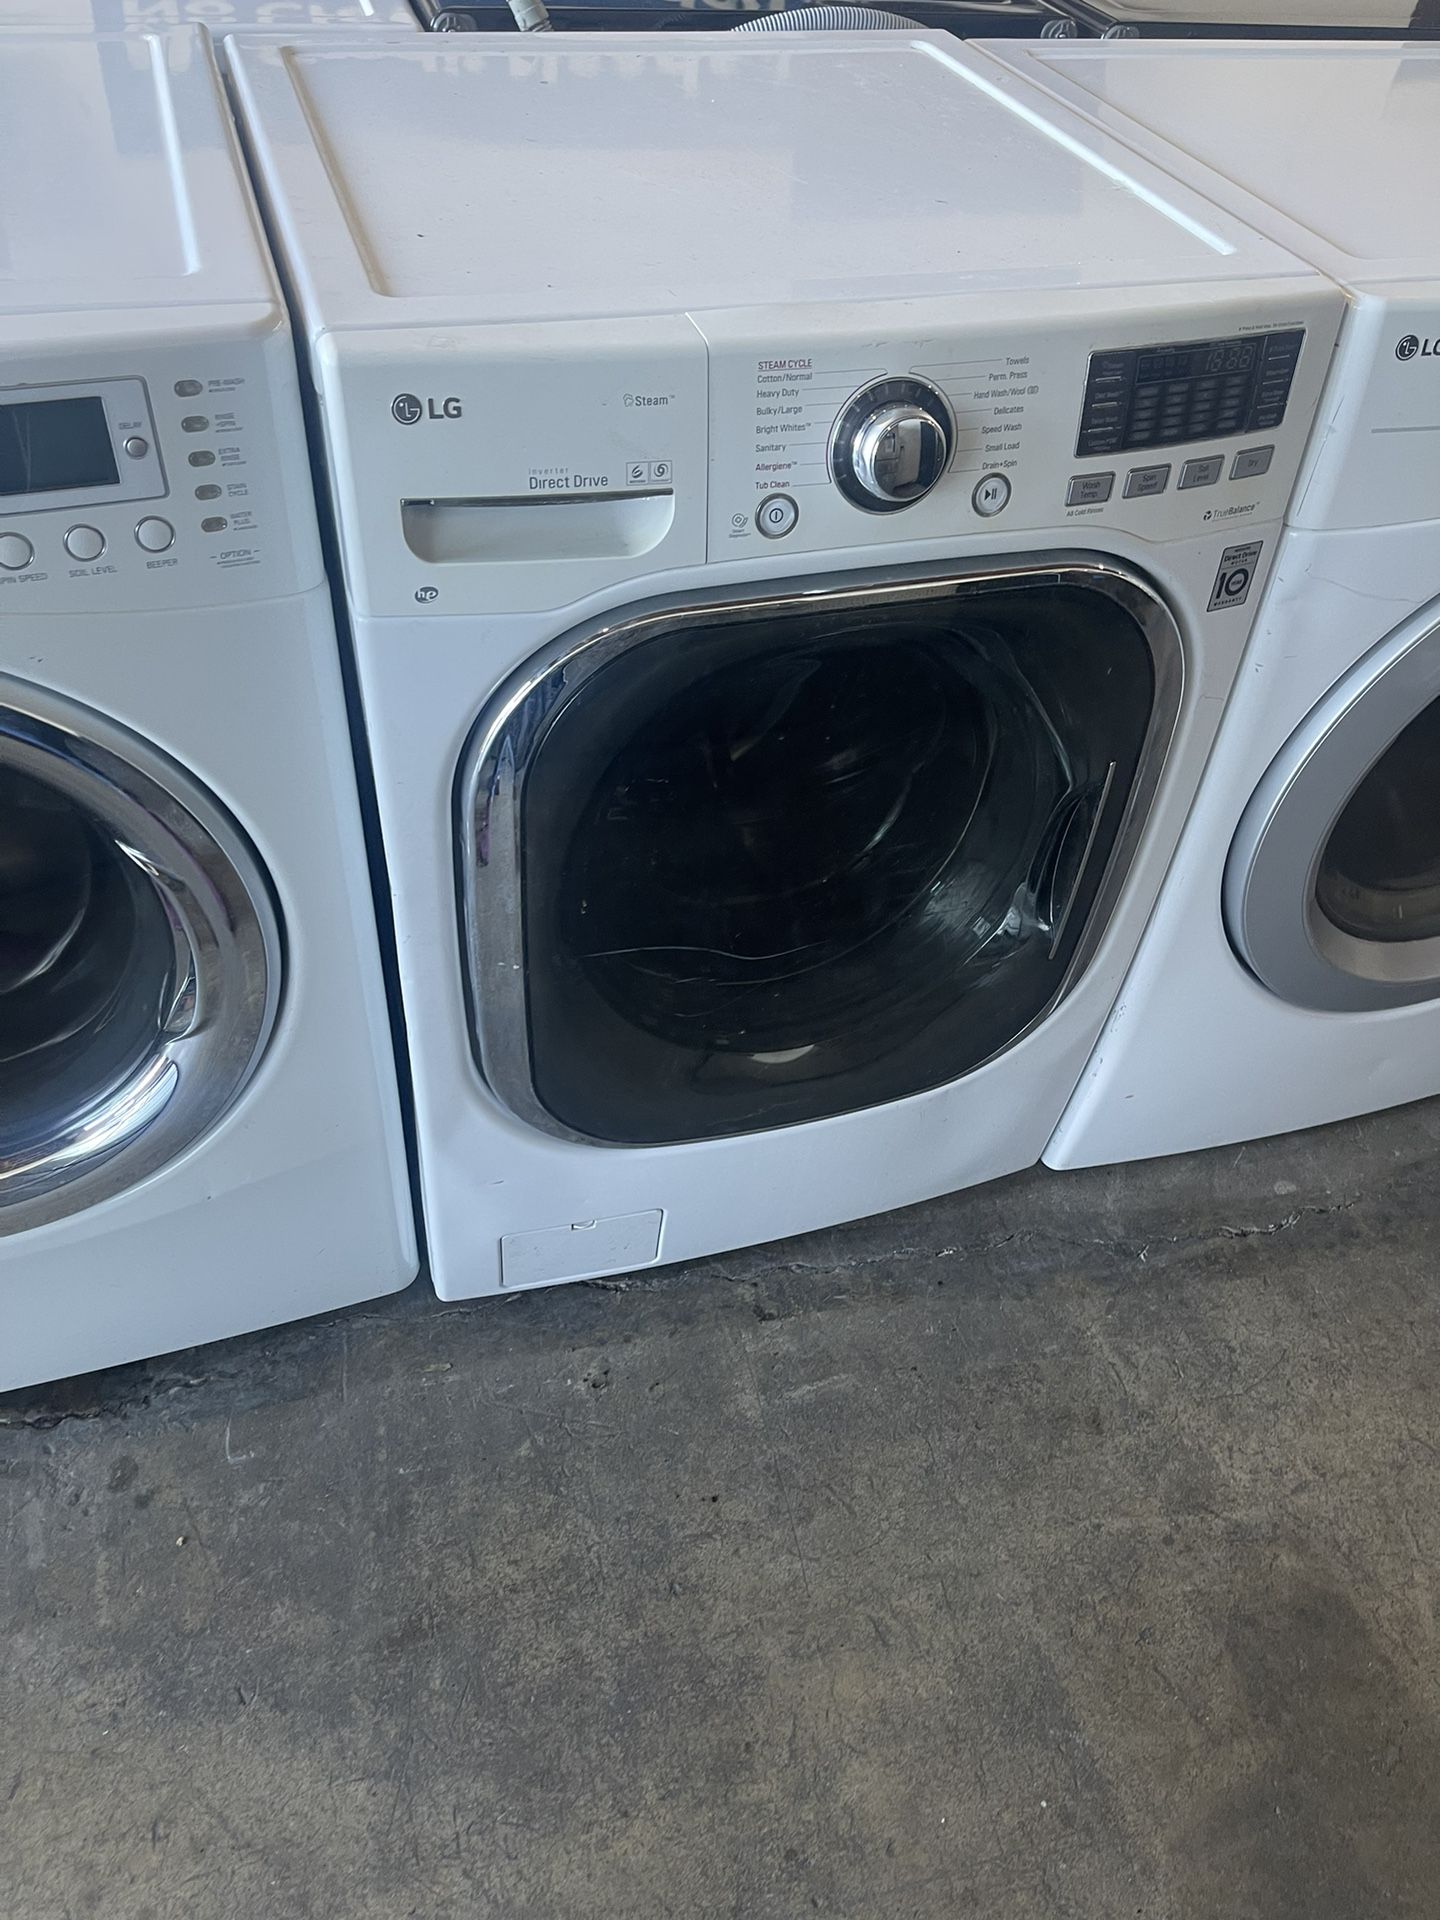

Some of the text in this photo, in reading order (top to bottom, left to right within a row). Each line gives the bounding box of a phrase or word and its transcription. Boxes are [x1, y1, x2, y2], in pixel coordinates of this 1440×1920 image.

[758, 358, 812, 370] STEAM CYCLE
[757, 372, 812, 383] Cotton/Normal
[756, 388, 799, 399] Heavy Duty
[428, 397, 462, 419] LG
[756, 405, 803, 416] Bulky/Large
[993, 406, 1024, 415] Delicates
[755, 424, 778, 435] Bright
[755, 443, 786, 453] Sanitary
[529, 474, 608, 490] Direct Drive
[755, 480, 790, 490] Tub Clean
[1224, 553, 1241, 562] Direct
[146, 558, 178, 569] BEEPER
[1216, 568, 1249, 599] 10
